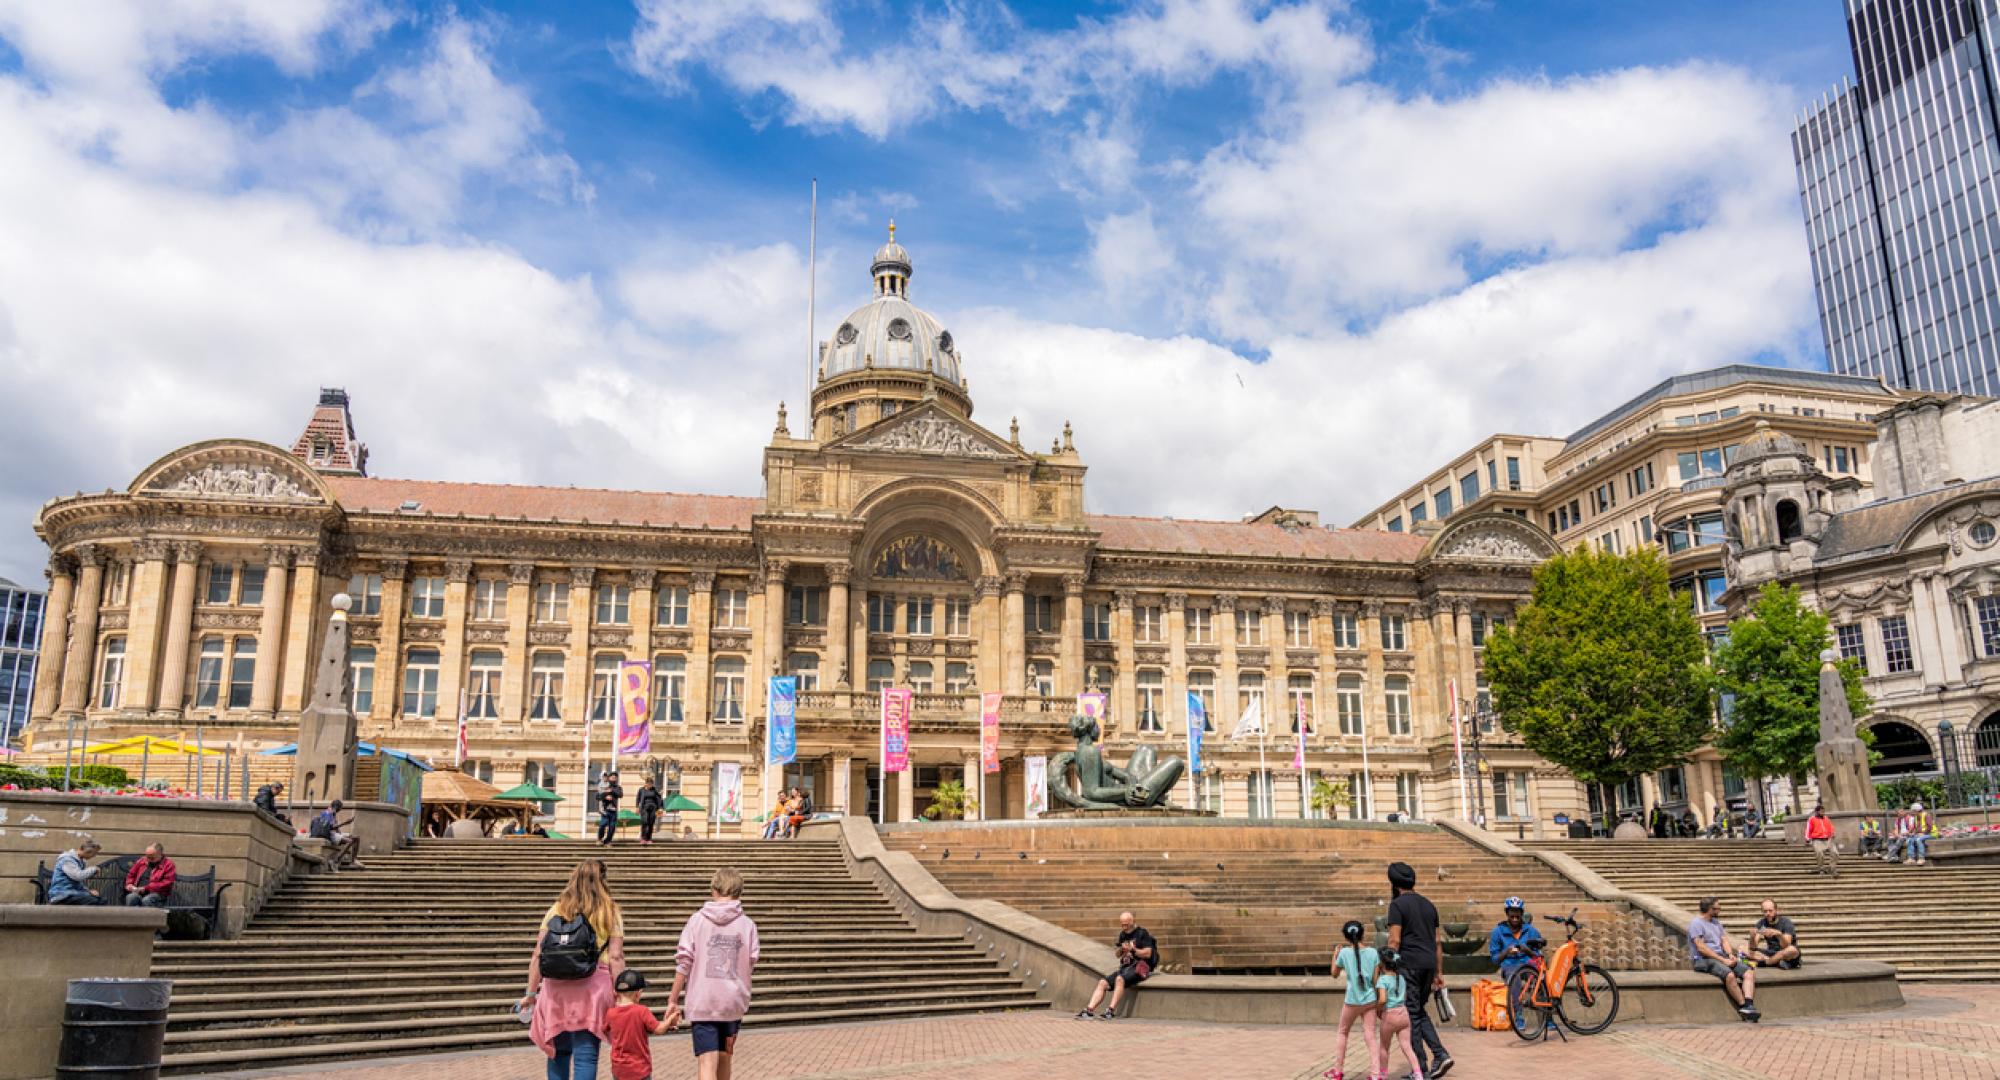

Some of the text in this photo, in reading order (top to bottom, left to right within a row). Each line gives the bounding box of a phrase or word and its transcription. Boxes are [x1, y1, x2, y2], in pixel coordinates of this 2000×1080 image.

[621, 665, 649, 727] B
[887, 693, 903, 729] BOLD
[887, 735, 904, 753] BE
